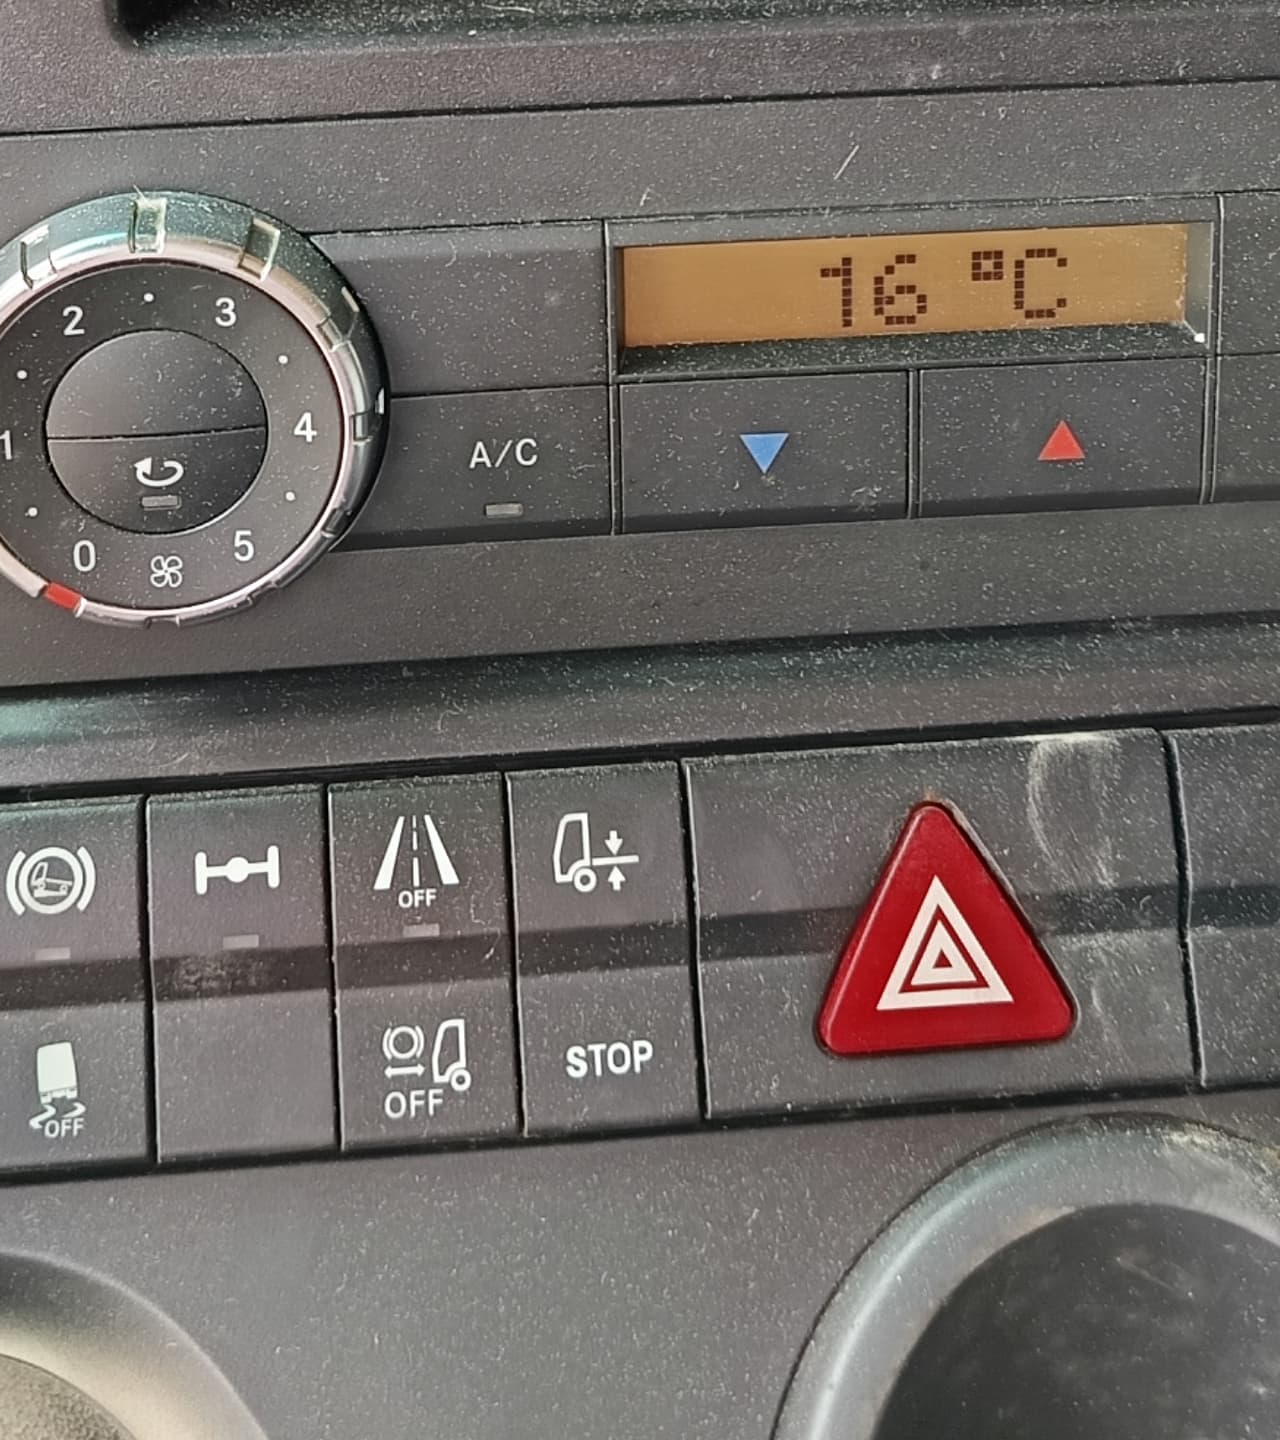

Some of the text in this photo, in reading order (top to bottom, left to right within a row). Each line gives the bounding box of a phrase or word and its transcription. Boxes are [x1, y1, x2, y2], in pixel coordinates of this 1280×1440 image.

[820, 253, 927, 328] 16
[62, 305, 85, 336] 2
[215, 297, 237, 327] 3
[293, 412, 318, 443] 4
[469, 438, 538, 469] A/C
[73, 539, 96, 572] 0
[234, 530, 254, 562] 5
[398, 888, 437, 909] OFF
[566, 1040, 653, 1078] STOP
[384, 1090, 443, 1119] OFF
[42, 1114, 84, 1138] OFF
